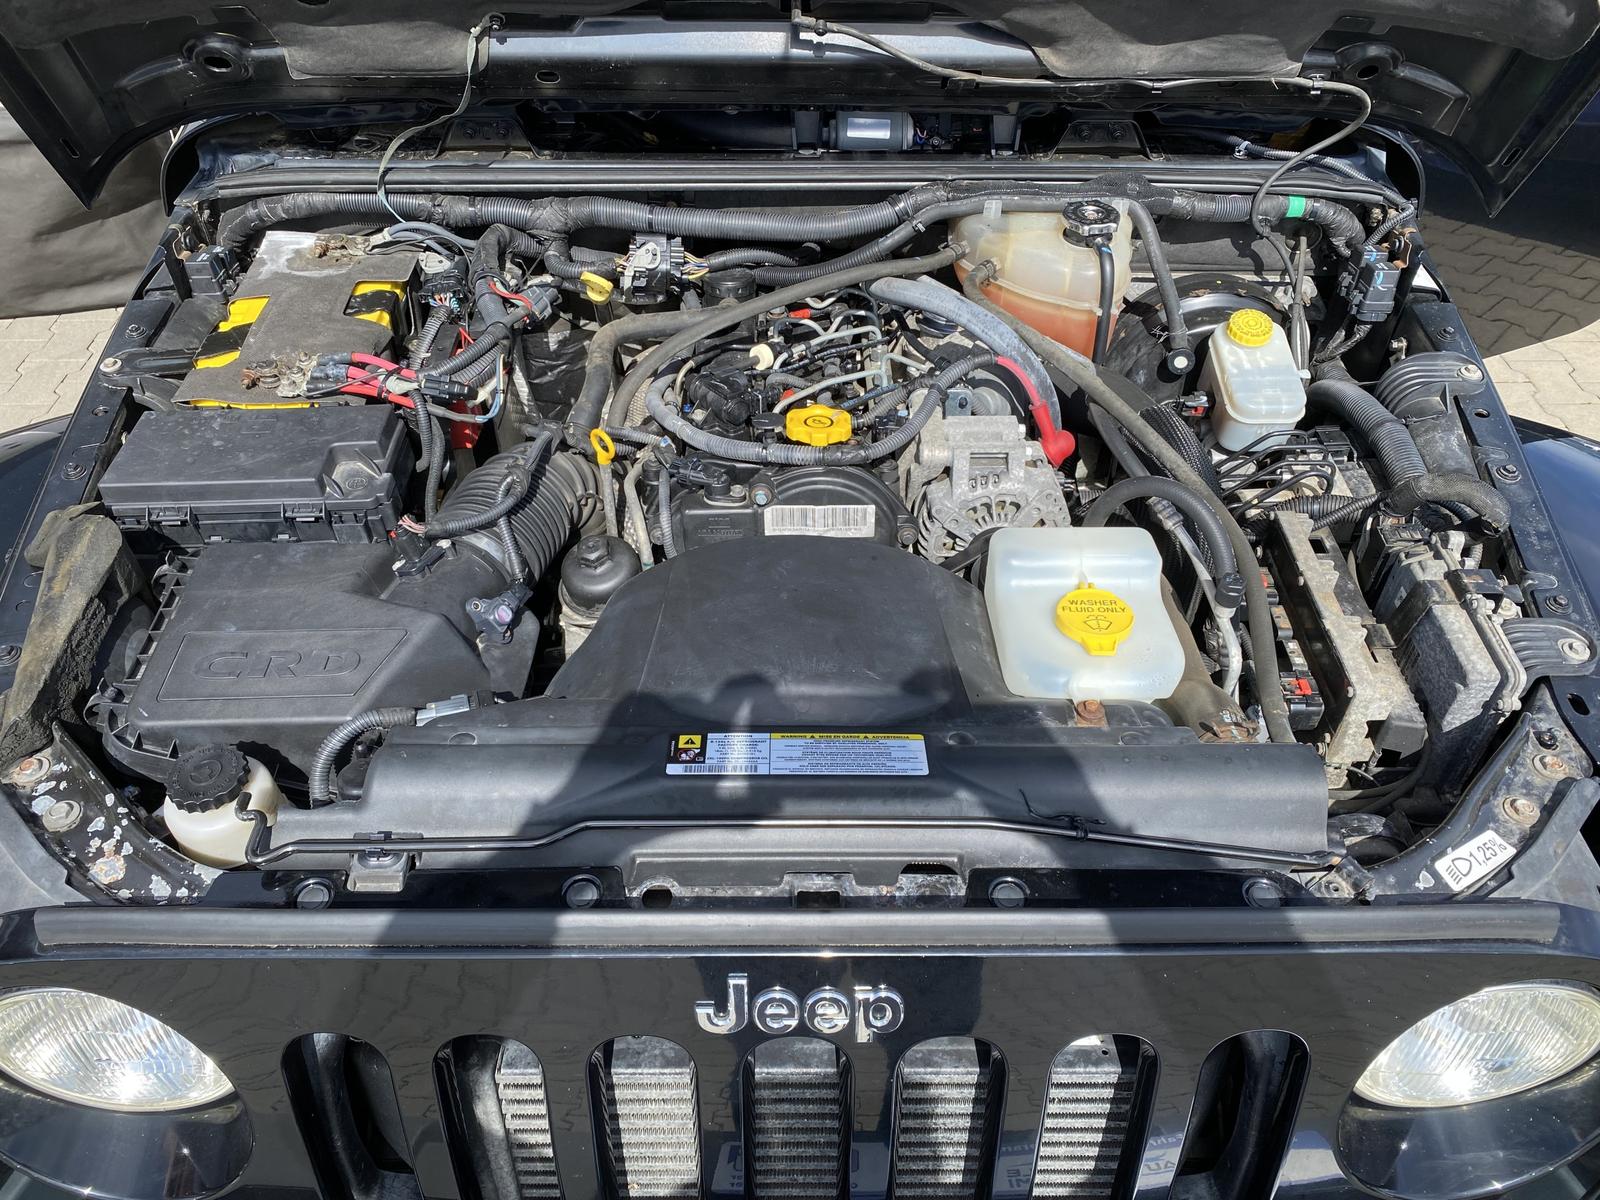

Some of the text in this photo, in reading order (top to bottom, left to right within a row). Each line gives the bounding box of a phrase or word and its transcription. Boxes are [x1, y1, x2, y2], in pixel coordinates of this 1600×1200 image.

[194, 651, 361, 680] CRD
[1469, 837, 1508, 867] 1,25%
[695, 973, 904, 1043] Jeep
